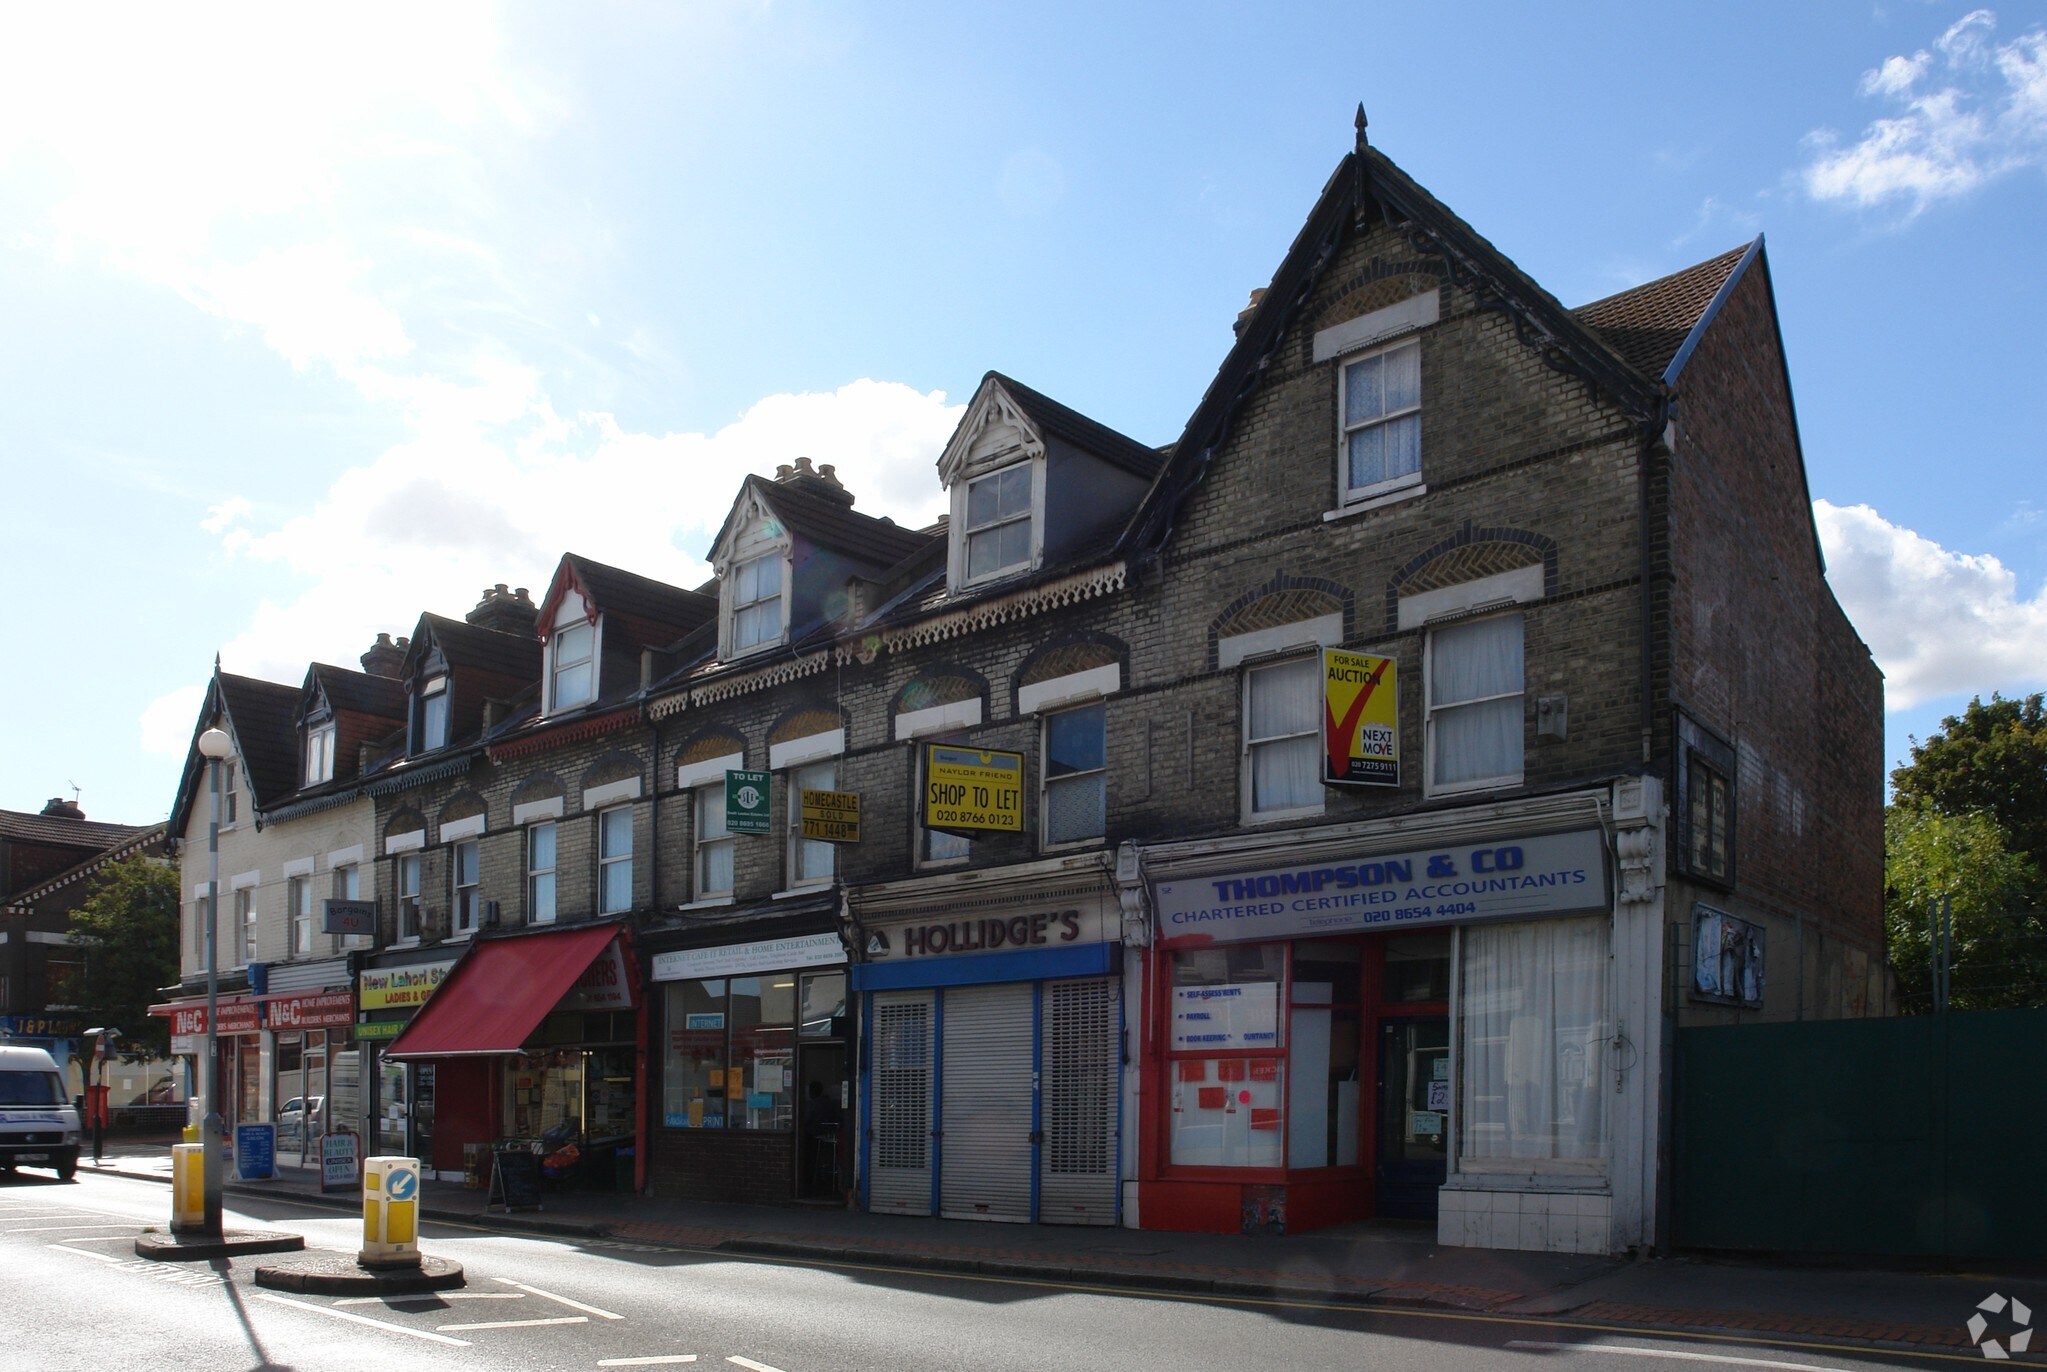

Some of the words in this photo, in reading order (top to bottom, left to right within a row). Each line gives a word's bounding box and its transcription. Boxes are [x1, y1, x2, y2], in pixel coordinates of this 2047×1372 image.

[1334, 655, 1350, 666] FOR
[1351, 657, 1369, 669] SALE
[1328, 667, 1381, 686] AUCTION
[1362, 729, 1393, 743] NEXT
[1362, 742, 1393, 756] MOVE
[1362, 761, 1380, 770] 7275
[1380, 762, 1397, 772] 9111
[733, 772, 745, 781] TO
[747, 774, 764, 782] LET
[939, 768, 976, 777] NAYLOR
[980, 771, 1013, 780] FRIEND
[803, 791, 857, 810] HOMECASTLE
[930, 782, 966, 806] SHOP
[973, 786, 989, 809] TO
[996, 788, 1019, 811] LET
[820, 811, 844, 820] SOLD
[936, 809, 958, 822] 020
[960, 811, 986, 824] 8766
[988, 813, 1014, 826] 0123
[803, 820, 820, 836] 771
[824, 822, 847, 838] 1448
[1212, 858, 1413, 902] THOMPSON
[1427, 854, 1457, 879] &
[1470, 845, 1524, 873] CO
[1171, 901, 1285, 925] CHARTERED
[1291, 889, 1398, 913] CERTIFIED
[1405, 868, 1587, 901] ACCOUNTANTS
[329, 906, 372, 919] Bargains
[1363, 909, 1390, 924] 020
[1394, 907, 1433, 921] 8654
[1436, 901, 1477, 918] 4404
[341, 916, 360, 929] 4U
[904, 909, 1081, 956] HOLLIDGE'S
[658, 954, 691, 965] INTERNET
[751, 944, 775, 954] HOME
[775, 936, 841, 952] ENTERTAINMENT
[363, 975, 389, 992] New
[316, 994, 351, 1006] IMPROVEMENTS
[385, 990, 411, 1005] LADIES
[412, 991, 419, 1002] &
[270, 999, 302, 1027] N&C
[301, 1015, 322, 1025] BUILDERS
[322, 1013, 351, 1024] MERCHANTS
[1186, 1012, 1211, 1021] PAYROLL
[26, 1018, 36, 1035] &
[176, 1009, 204, 1035] N&C
[227, 1020, 255, 1031] MERCHANTS
[689, 1018, 722, 1029] INTERNET
[359, 1026, 381, 1037] UNISEX
[382, 1025, 399, 1036] HAIR
[704, 1116, 724, 1128] PRINT
[326, 1139, 346, 1148] HAIR
[347, 1139, 354, 1147] &
[323, 1147, 354, 1158] BEAUTY
[328, 1157, 352, 1165] UNISEX
[328, 1164, 351, 1174] OPEN
